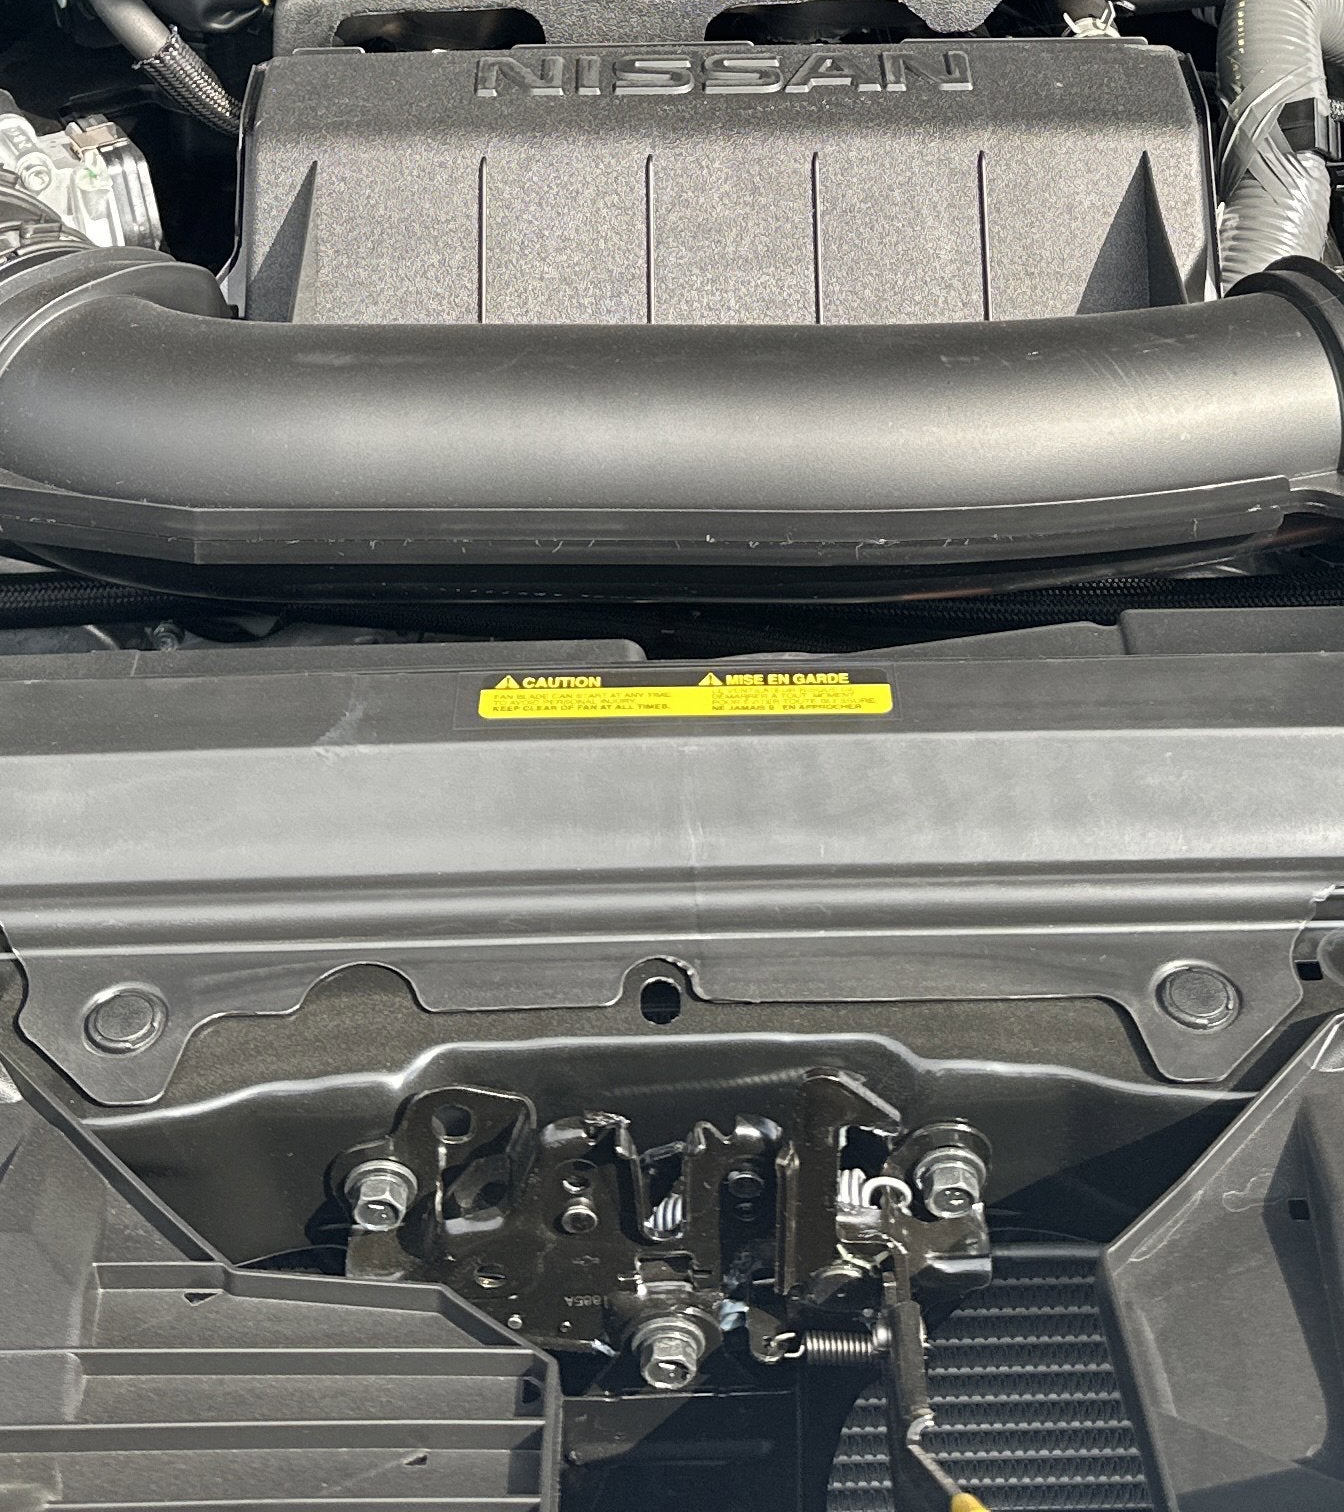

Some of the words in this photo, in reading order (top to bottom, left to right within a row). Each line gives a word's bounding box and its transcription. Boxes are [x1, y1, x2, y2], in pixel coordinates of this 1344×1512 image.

[475, 51, 973, 97] NISSAN
[522, 676, 602, 689] CAUTION
[725, 674, 764, 686] MISE
[767, 673, 790, 685] EN
[792, 672, 850, 685] GARDE
